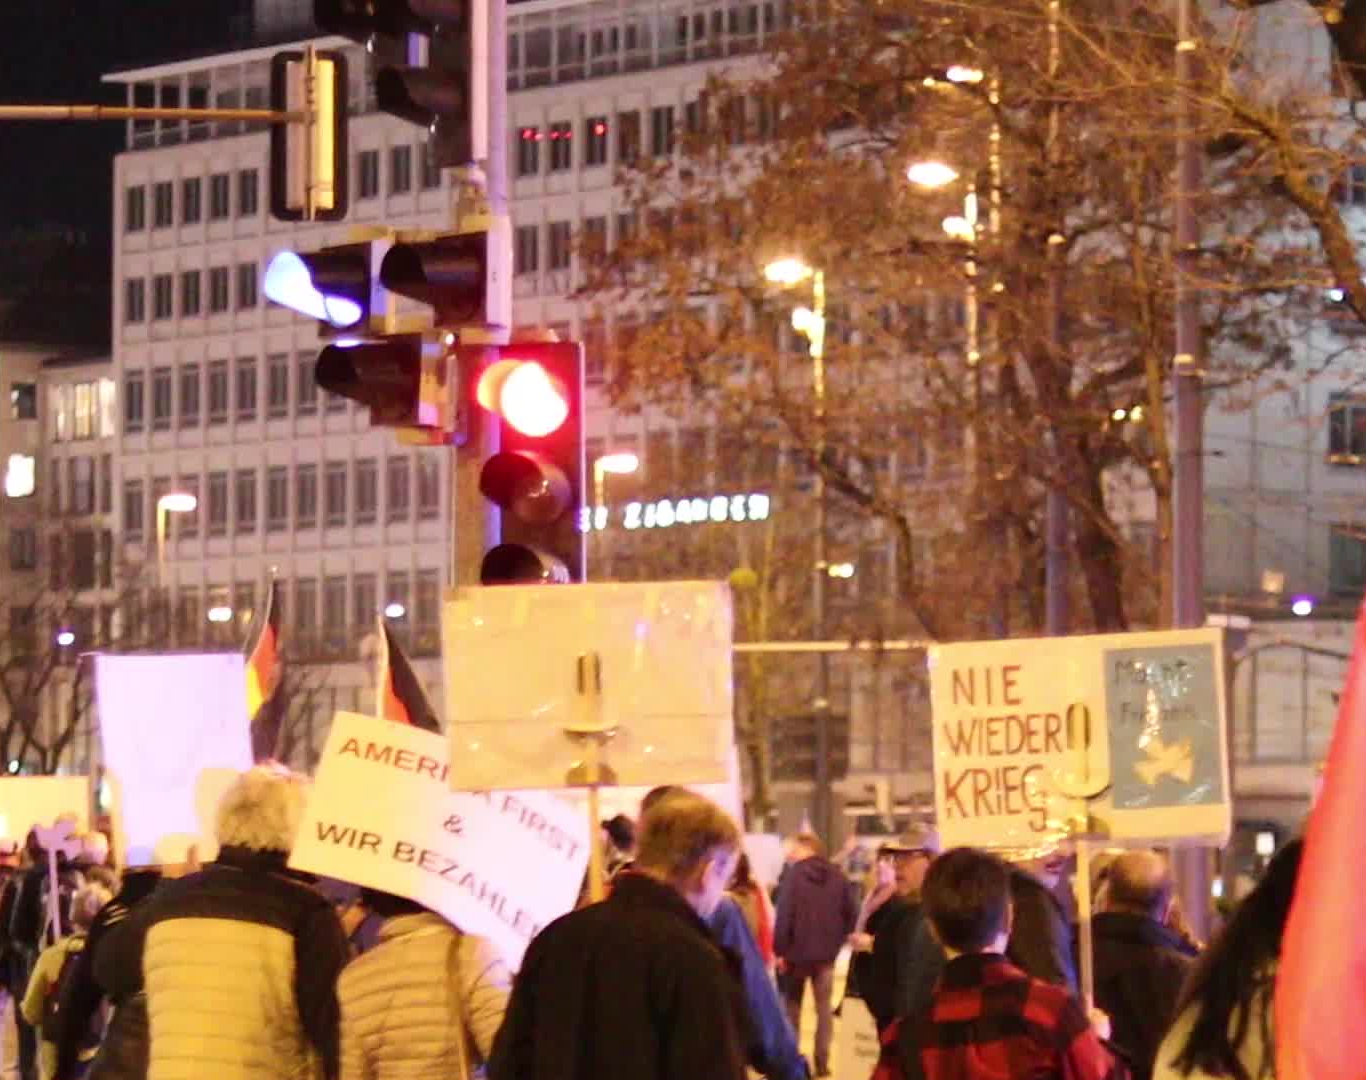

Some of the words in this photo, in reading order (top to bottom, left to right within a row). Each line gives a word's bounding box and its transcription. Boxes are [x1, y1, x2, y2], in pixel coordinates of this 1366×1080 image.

[951, 664, 1024, 705] NIE
[943, 712, 1063, 757] WIEDER
[943, 764, 1050, 833] KRIEG
[443, 815, 464, 840] &
[316, 821, 383, 854] WIR
[392, 841, 539, 939] BEZAHLE
